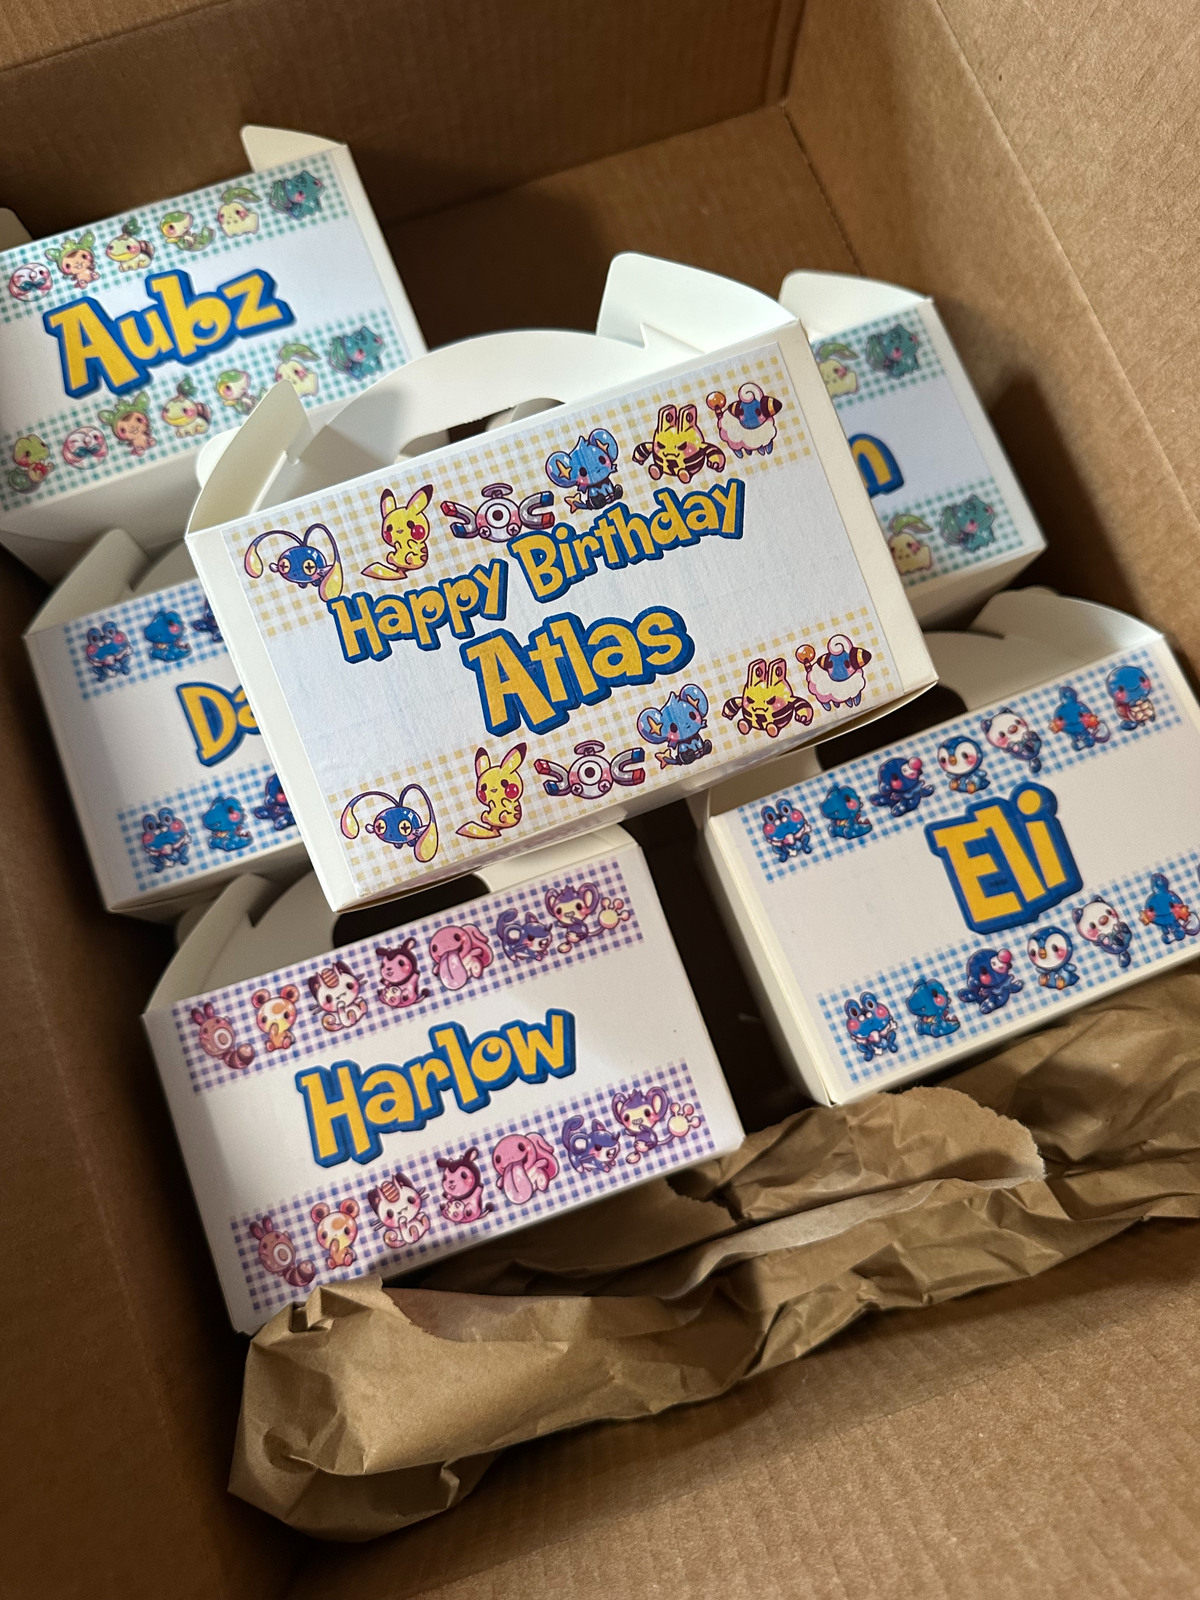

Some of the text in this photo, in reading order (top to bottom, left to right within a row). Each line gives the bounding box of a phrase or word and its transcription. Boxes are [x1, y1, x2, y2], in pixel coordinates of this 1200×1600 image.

[45, 269, 294, 399] Aubz
[328, 478, 746, 663] Happy Birthday
[460, 606, 695, 736] Atlas
[924, 781, 1084, 935] Eli
[294, 1009, 576, 1168] Harlow
